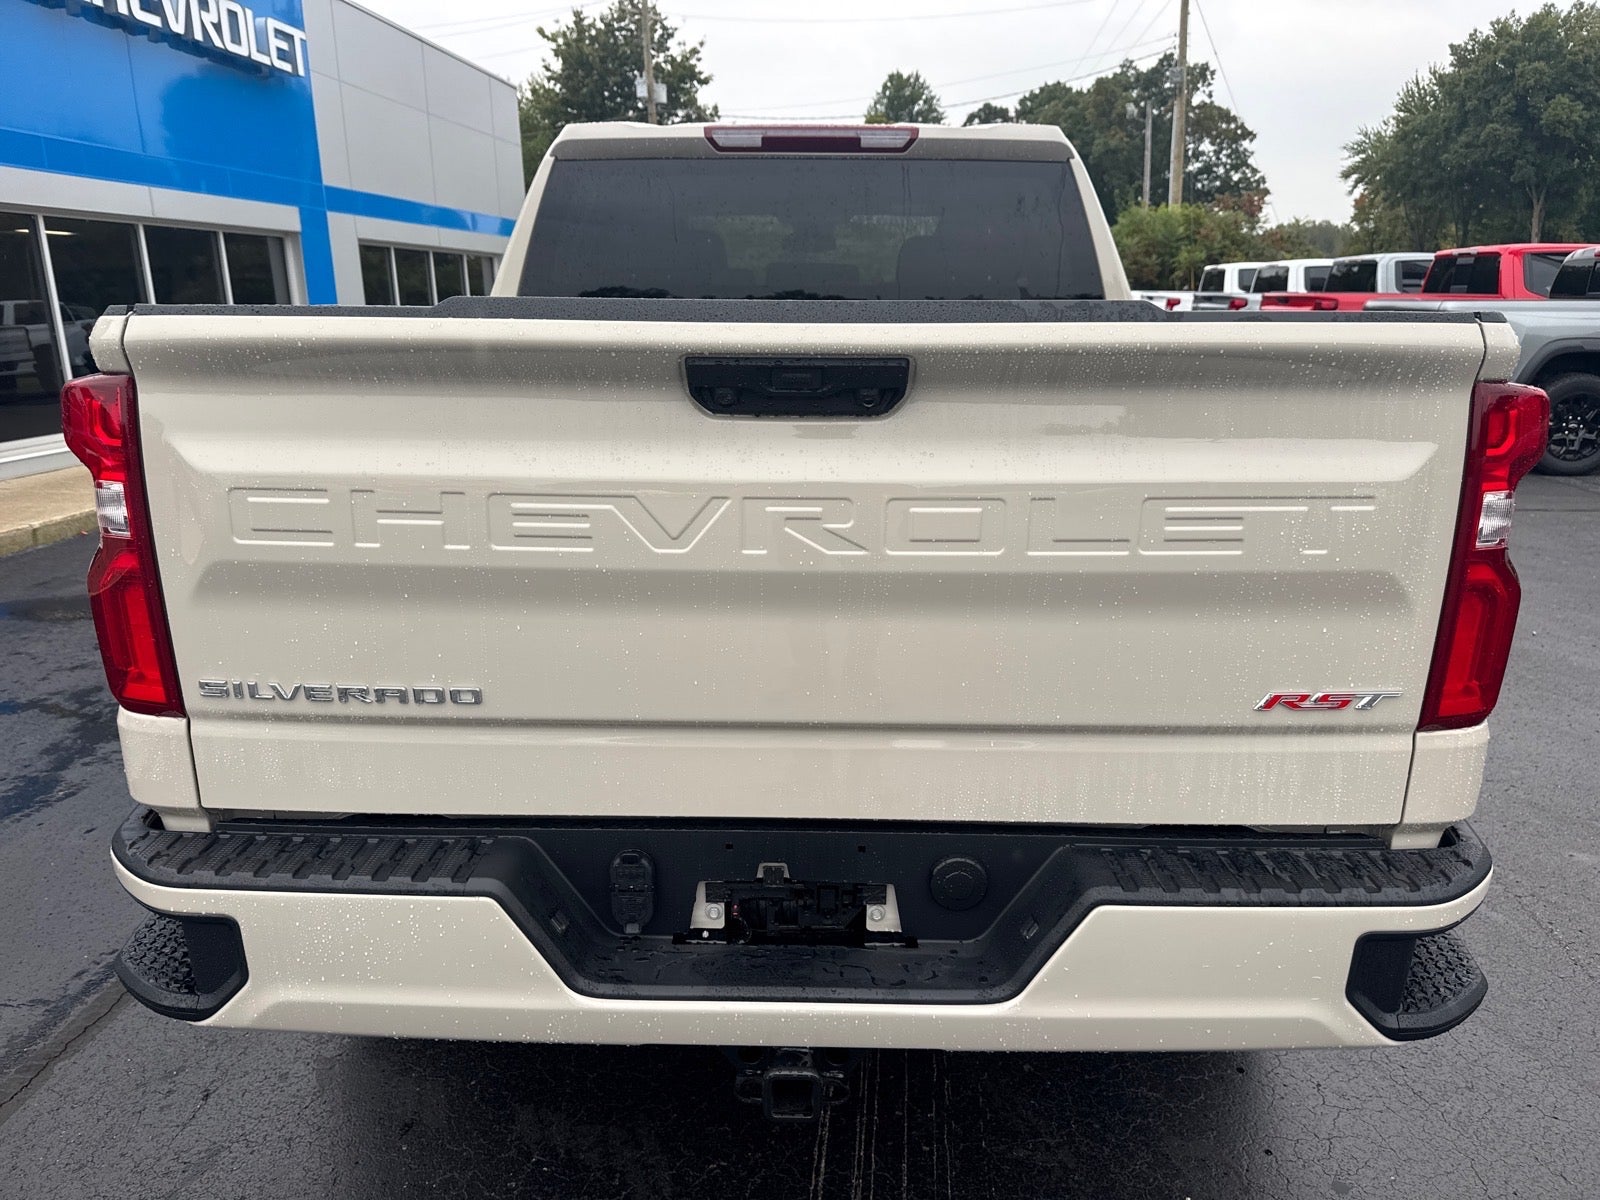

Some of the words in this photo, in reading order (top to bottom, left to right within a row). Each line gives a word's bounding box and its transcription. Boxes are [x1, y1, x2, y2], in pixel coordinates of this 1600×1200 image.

[228, 487, 1376, 556] CHEVROLET
[199, 679, 482, 705] SILVERADO
[1253, 691, 1403, 711] RST
